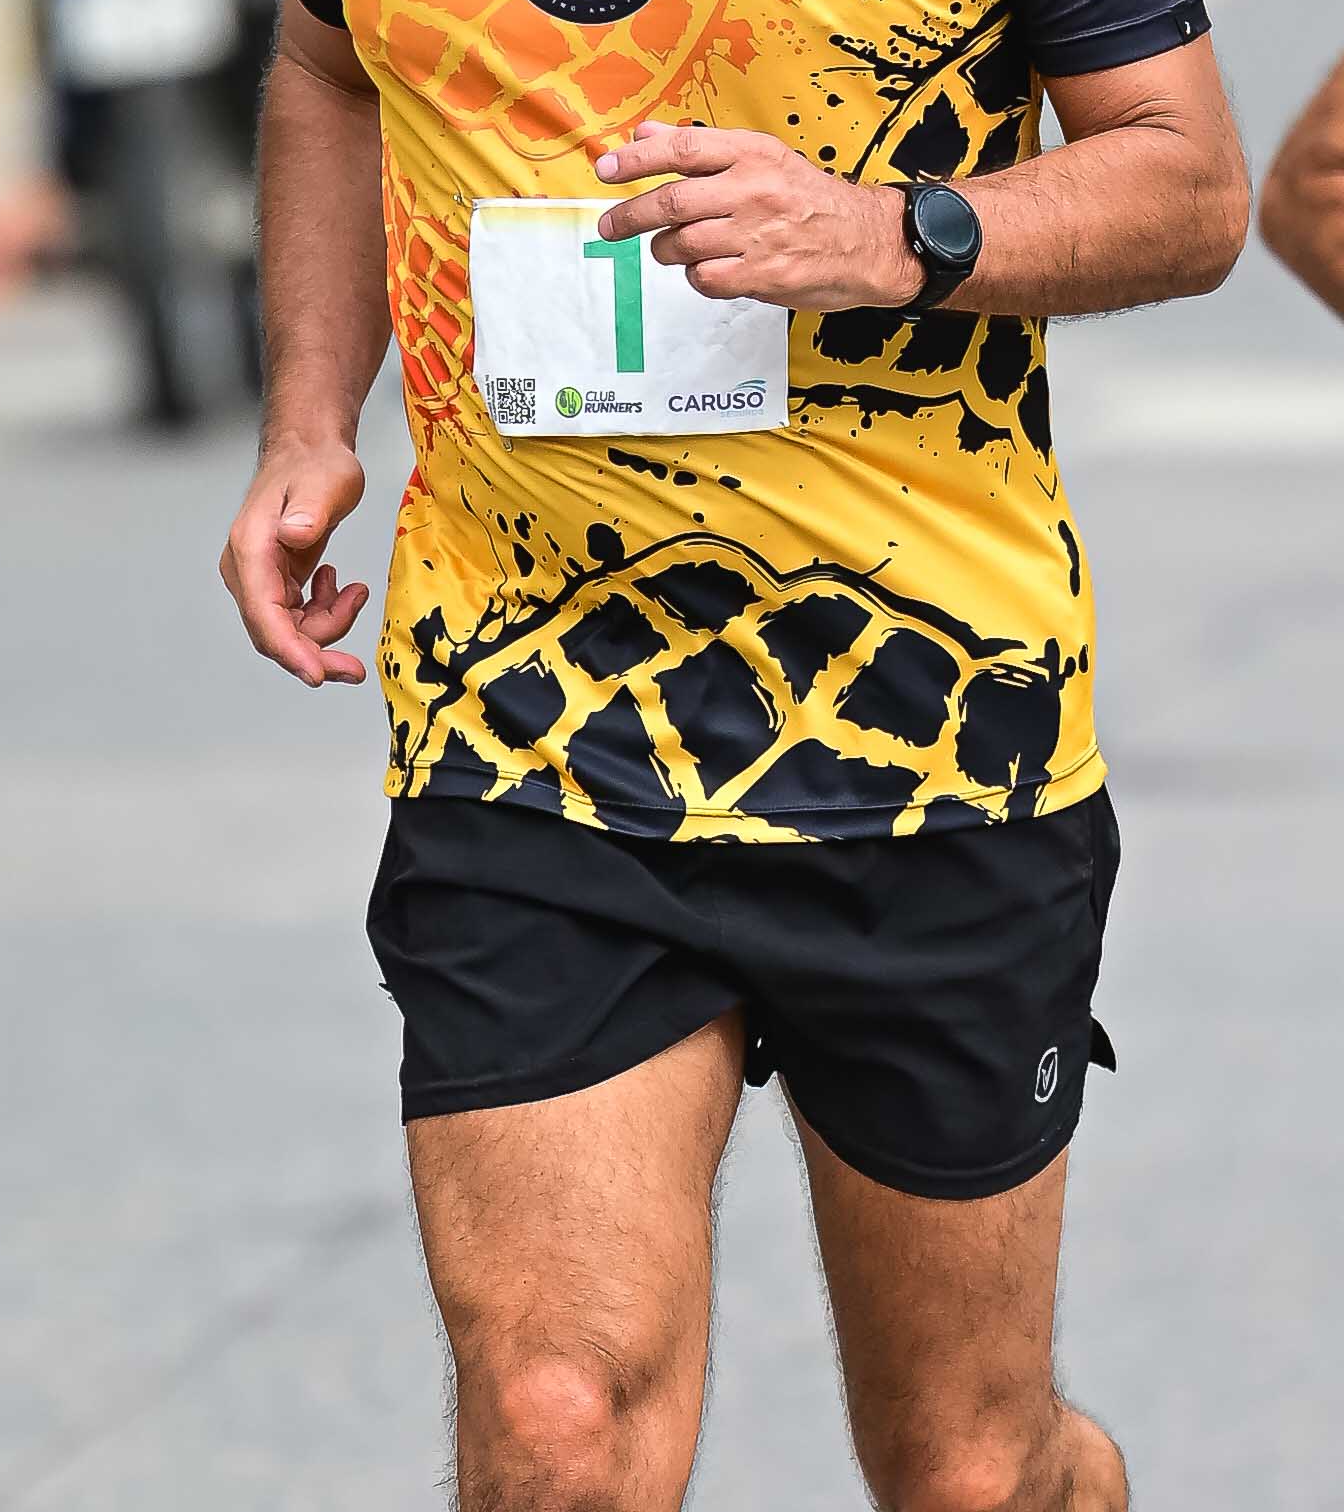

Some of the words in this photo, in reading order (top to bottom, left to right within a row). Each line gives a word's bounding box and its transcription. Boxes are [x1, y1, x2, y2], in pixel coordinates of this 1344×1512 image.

[583, 235, 645, 373] 1
[585, 390, 616, 402] CLUB
[668, 391, 764, 412] CARUSO
[584, 402, 643, 414] RUNNER'S
